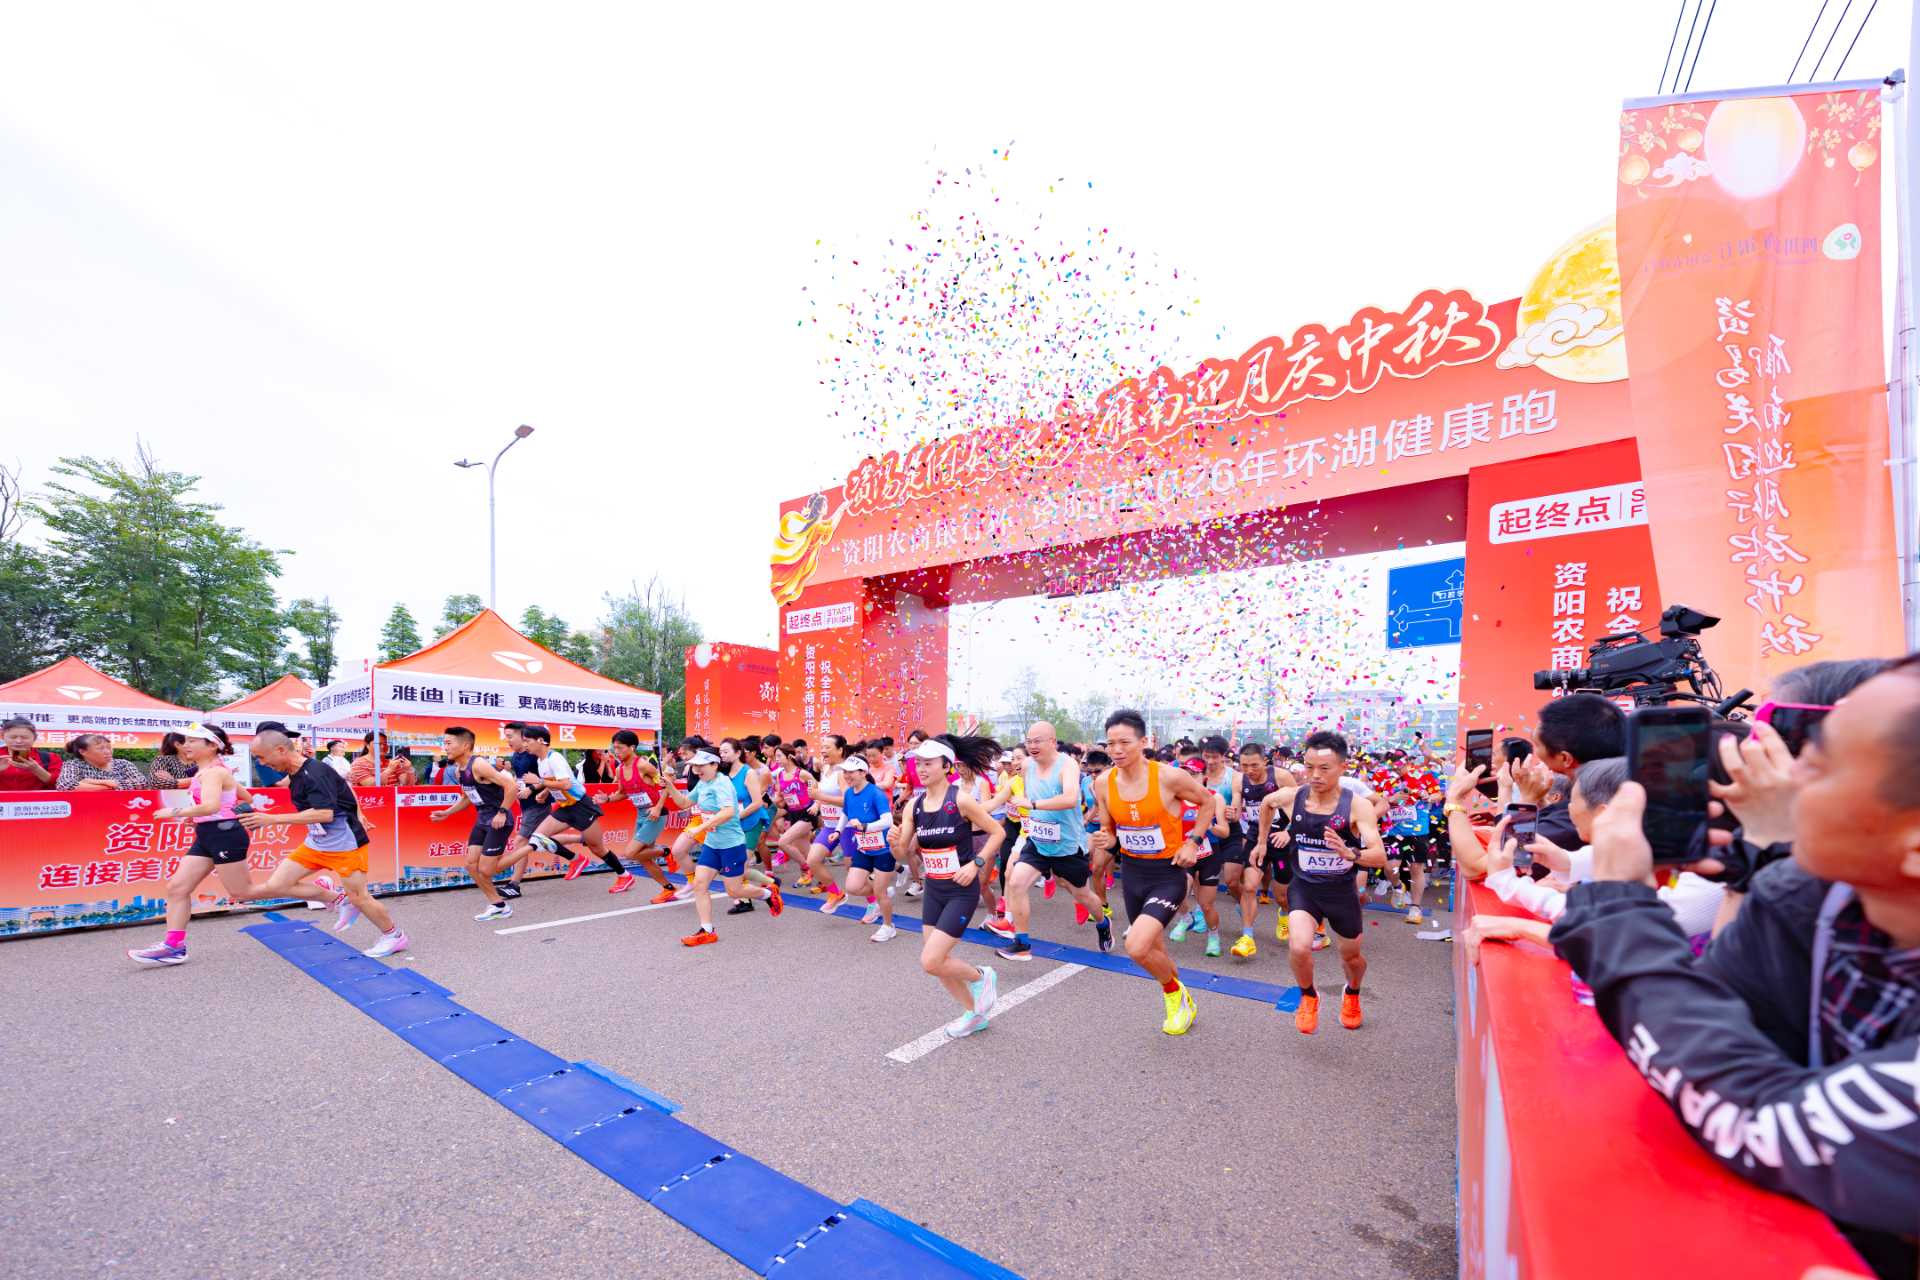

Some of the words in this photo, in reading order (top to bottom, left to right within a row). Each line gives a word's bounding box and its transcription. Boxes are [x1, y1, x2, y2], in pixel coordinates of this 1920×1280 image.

[1631, 489, 1645, 502] S
[1498, 496, 1611, 536] 起终点
[1631, 505, 1645, 518] F
[790, 612, 822, 630] 起终点
[1551, 562, 1588, 697] 资阳农商
[392, 684, 444, 703] 雅迪
[459, 690, 504, 708] 冠能
[518, 695, 653, 720] 更高端的长续航电动车
[820, 660, 832, 739] 祝全市人民
[105, 820, 290, 856] 资阳政
[1033, 826, 1054, 836] A516
[1126, 834, 1155, 846] A539
[429, 841, 470, 858] 让金
[1308, 856, 1344, 867] A572
